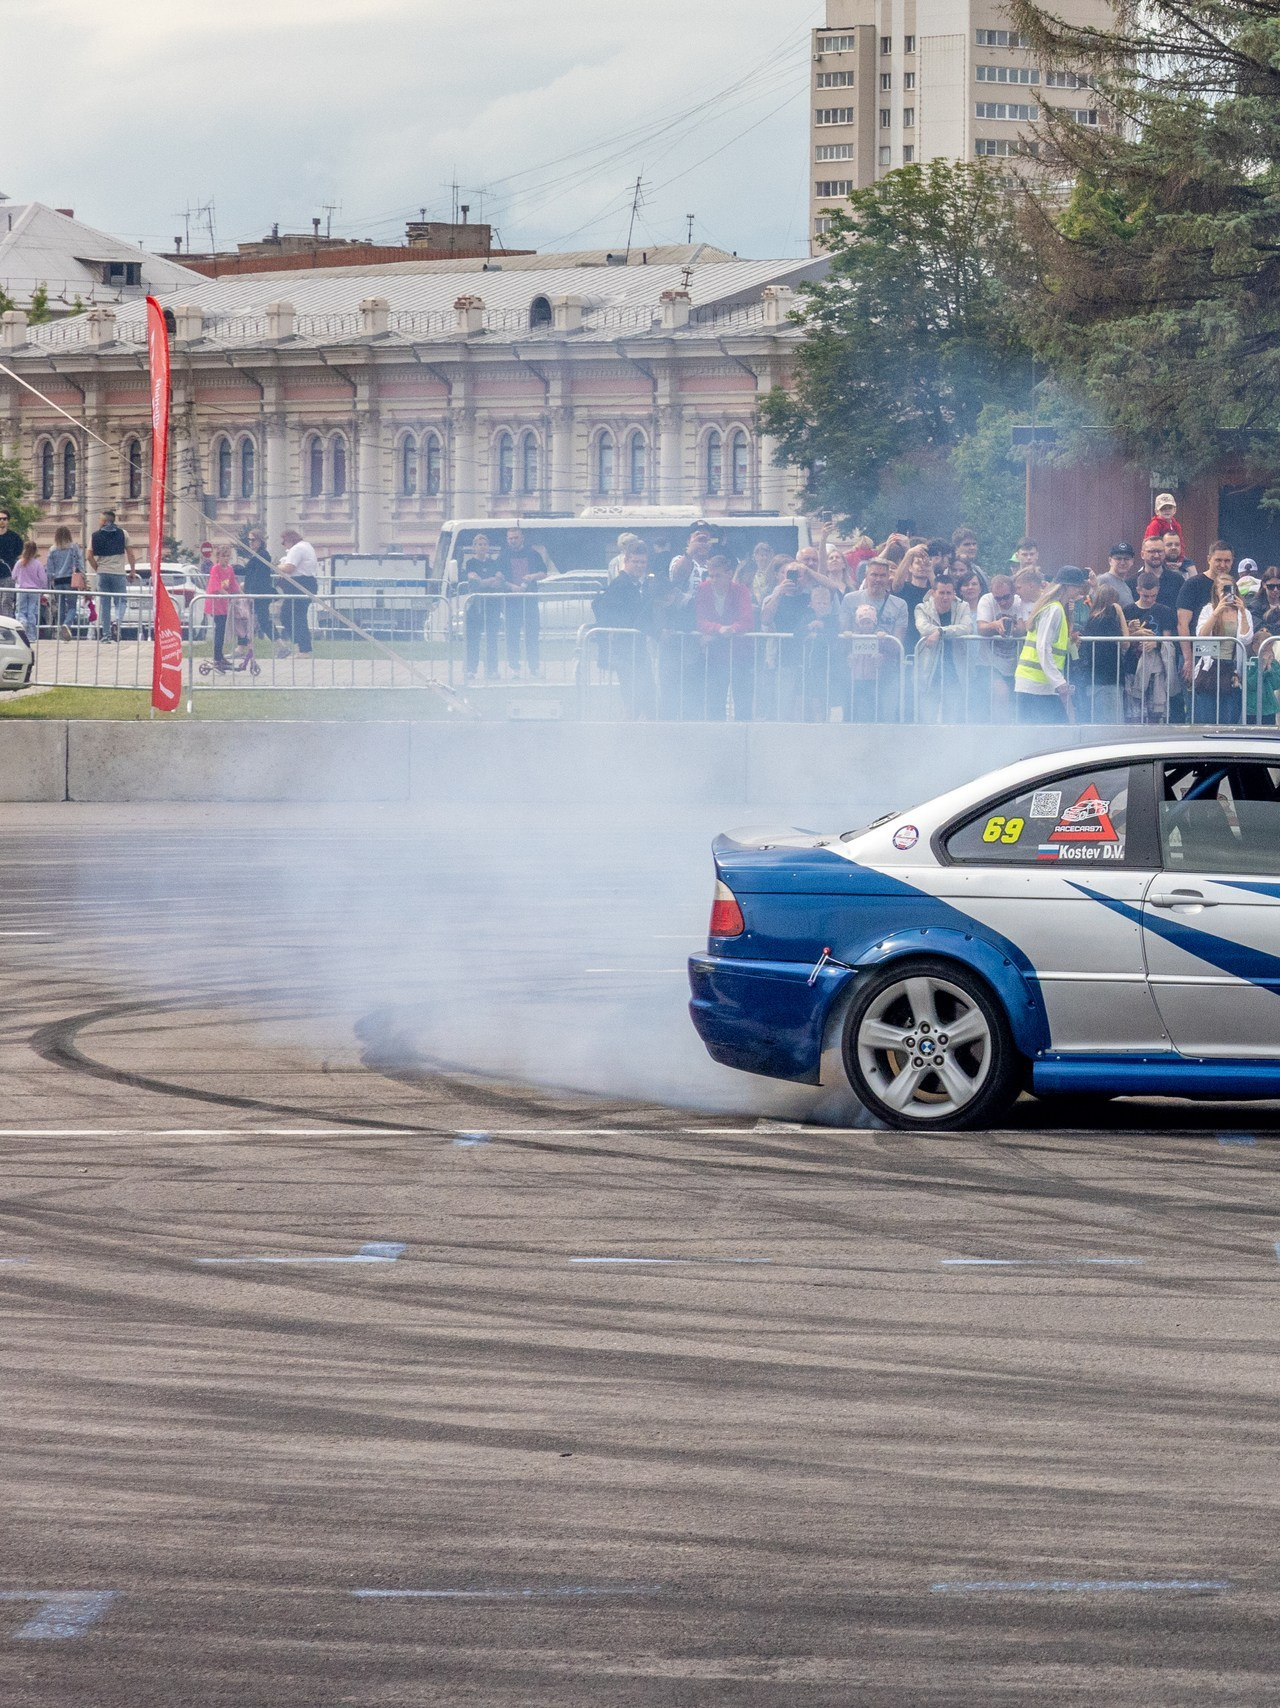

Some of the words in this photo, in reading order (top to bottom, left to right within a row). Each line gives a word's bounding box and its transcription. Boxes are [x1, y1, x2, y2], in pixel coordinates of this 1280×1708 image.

[982, 816, 1025, 844] 69
[1058, 845, 1100, 859] Kostev
[1103, 845, 1124, 859] D.V.
